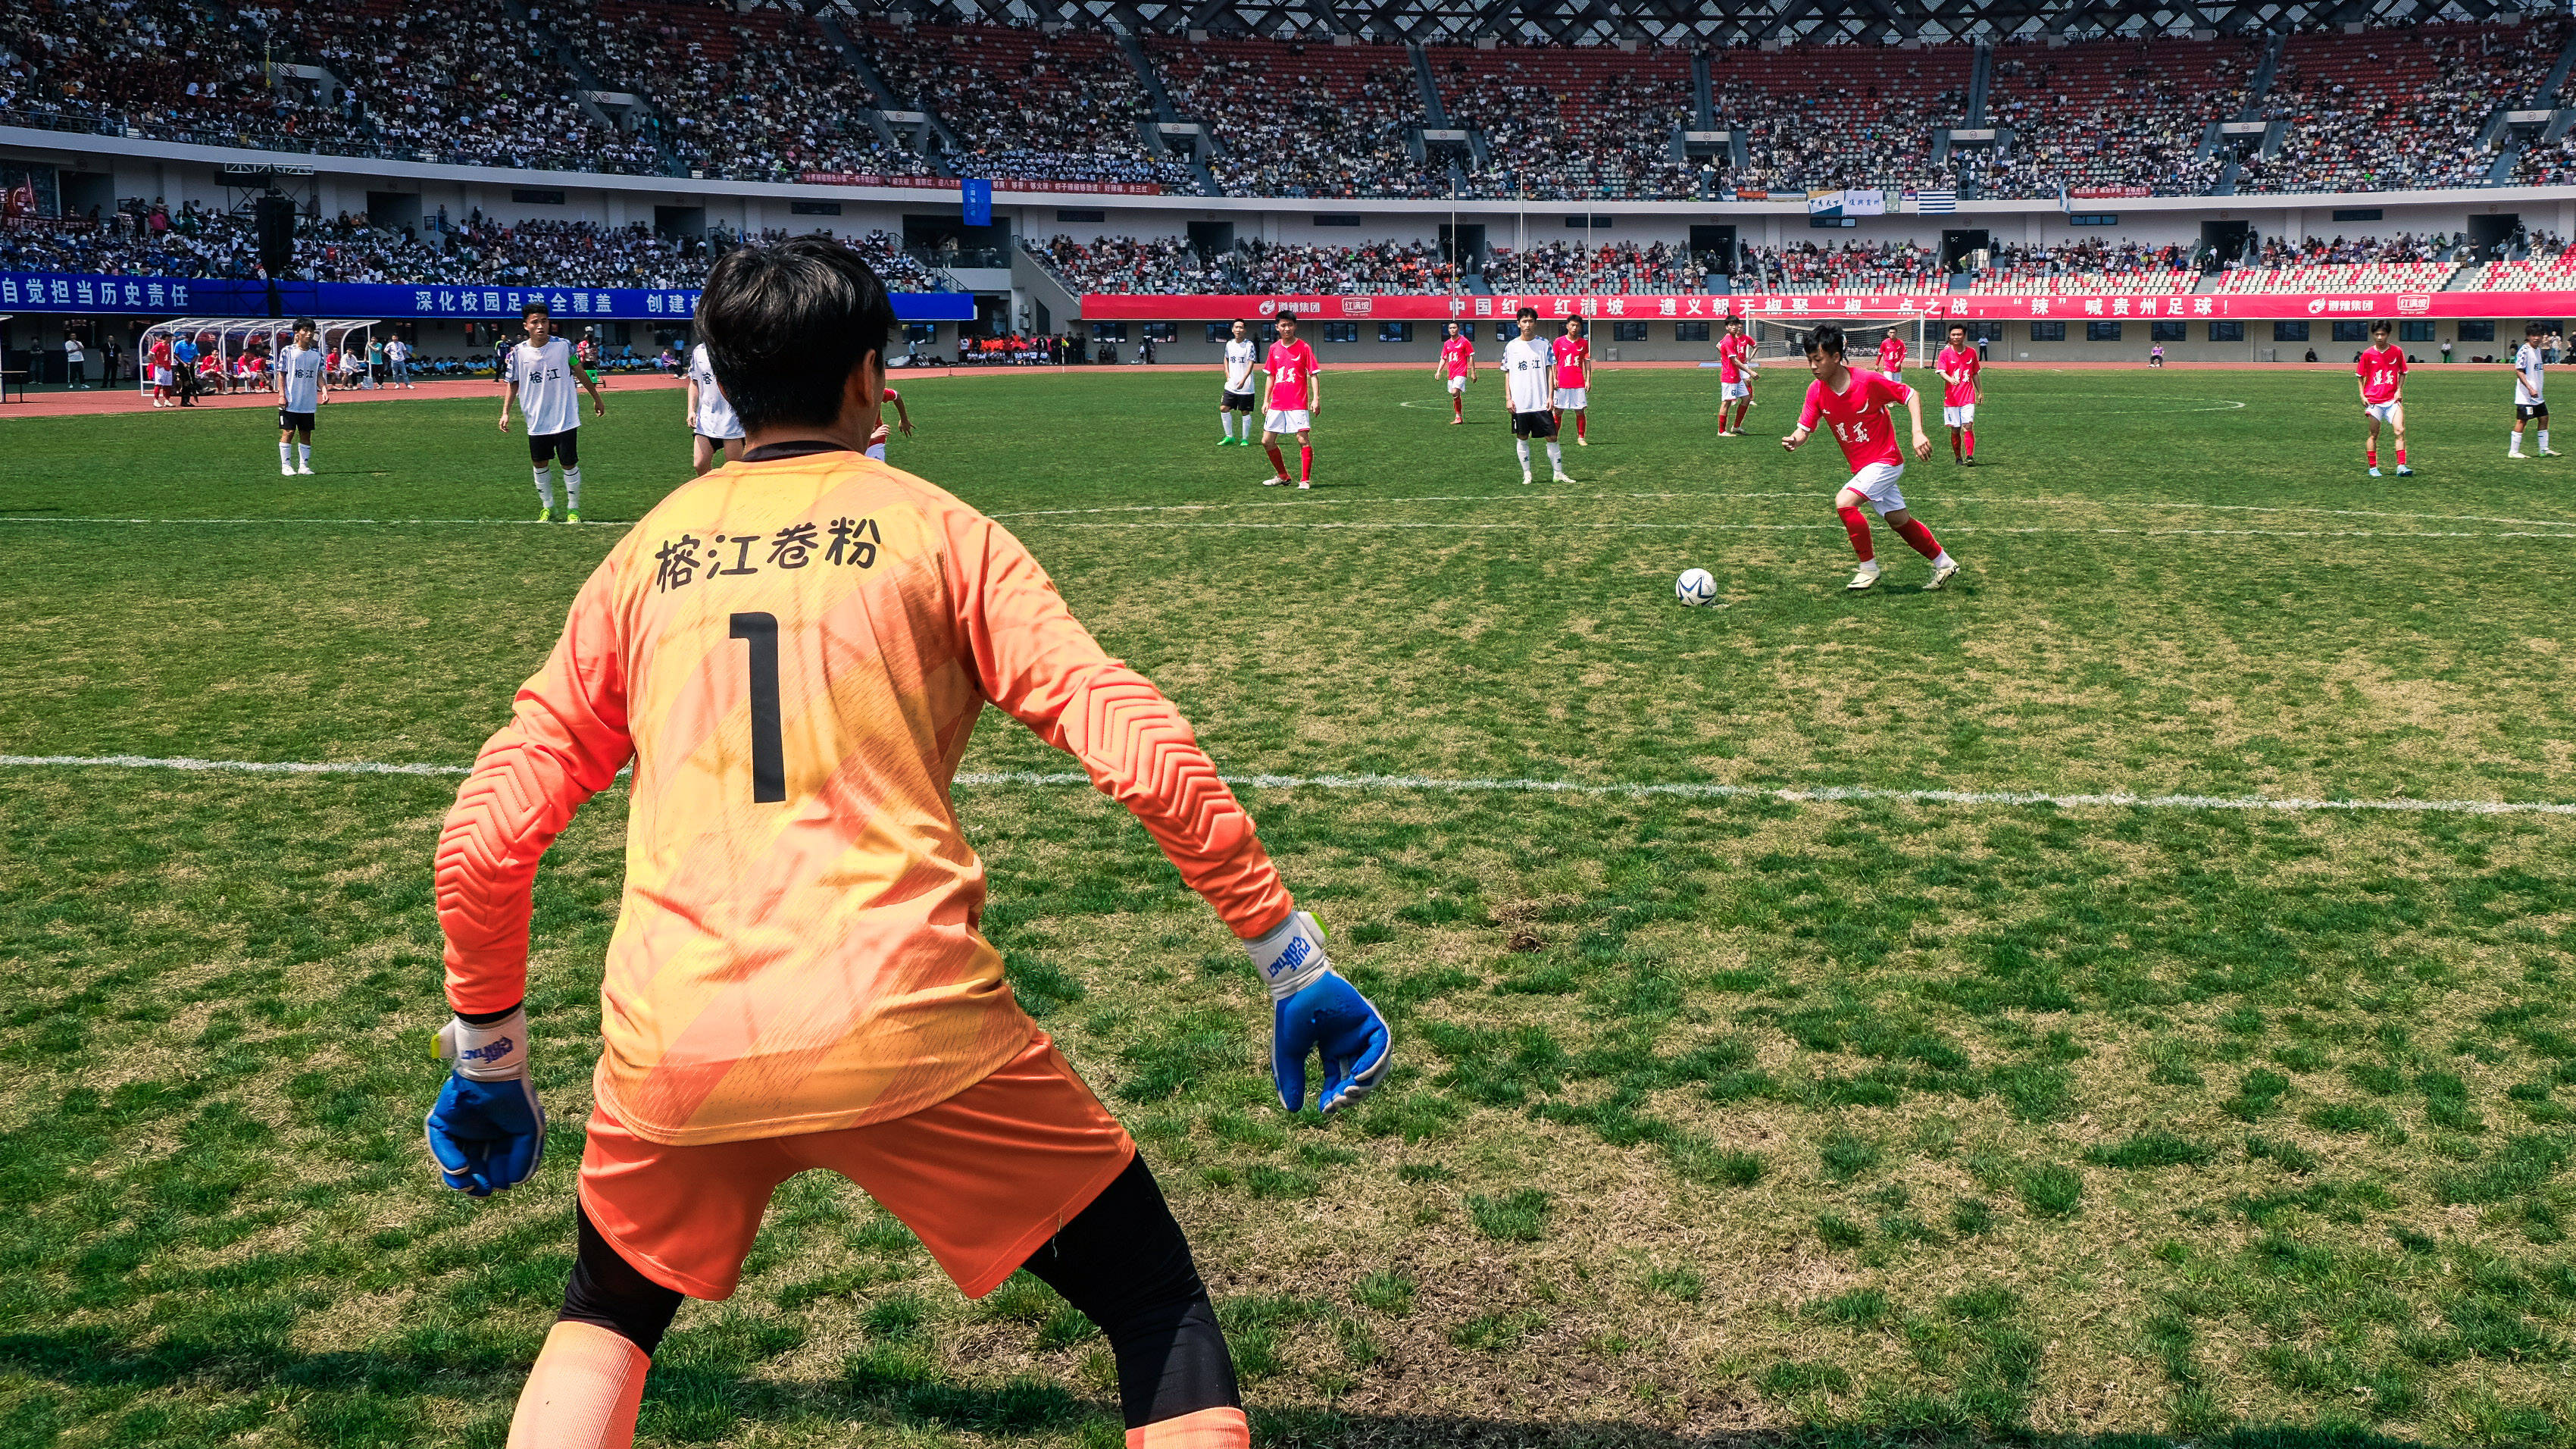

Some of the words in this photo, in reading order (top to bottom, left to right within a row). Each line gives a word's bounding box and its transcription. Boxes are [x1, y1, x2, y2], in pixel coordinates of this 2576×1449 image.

[2, 277, 189, 308] 自觉担当历史责任
[415, 290, 612, 313] 深化校园足球全覆盖
[294, 369, 314, 379] 榕江
[529, 368, 561, 383] 榕江
[1518, 359, 1541, 371] 榕江
[655, 516, 881, 593] 榕江卷粉
[729, 611, 786, 804] 1
